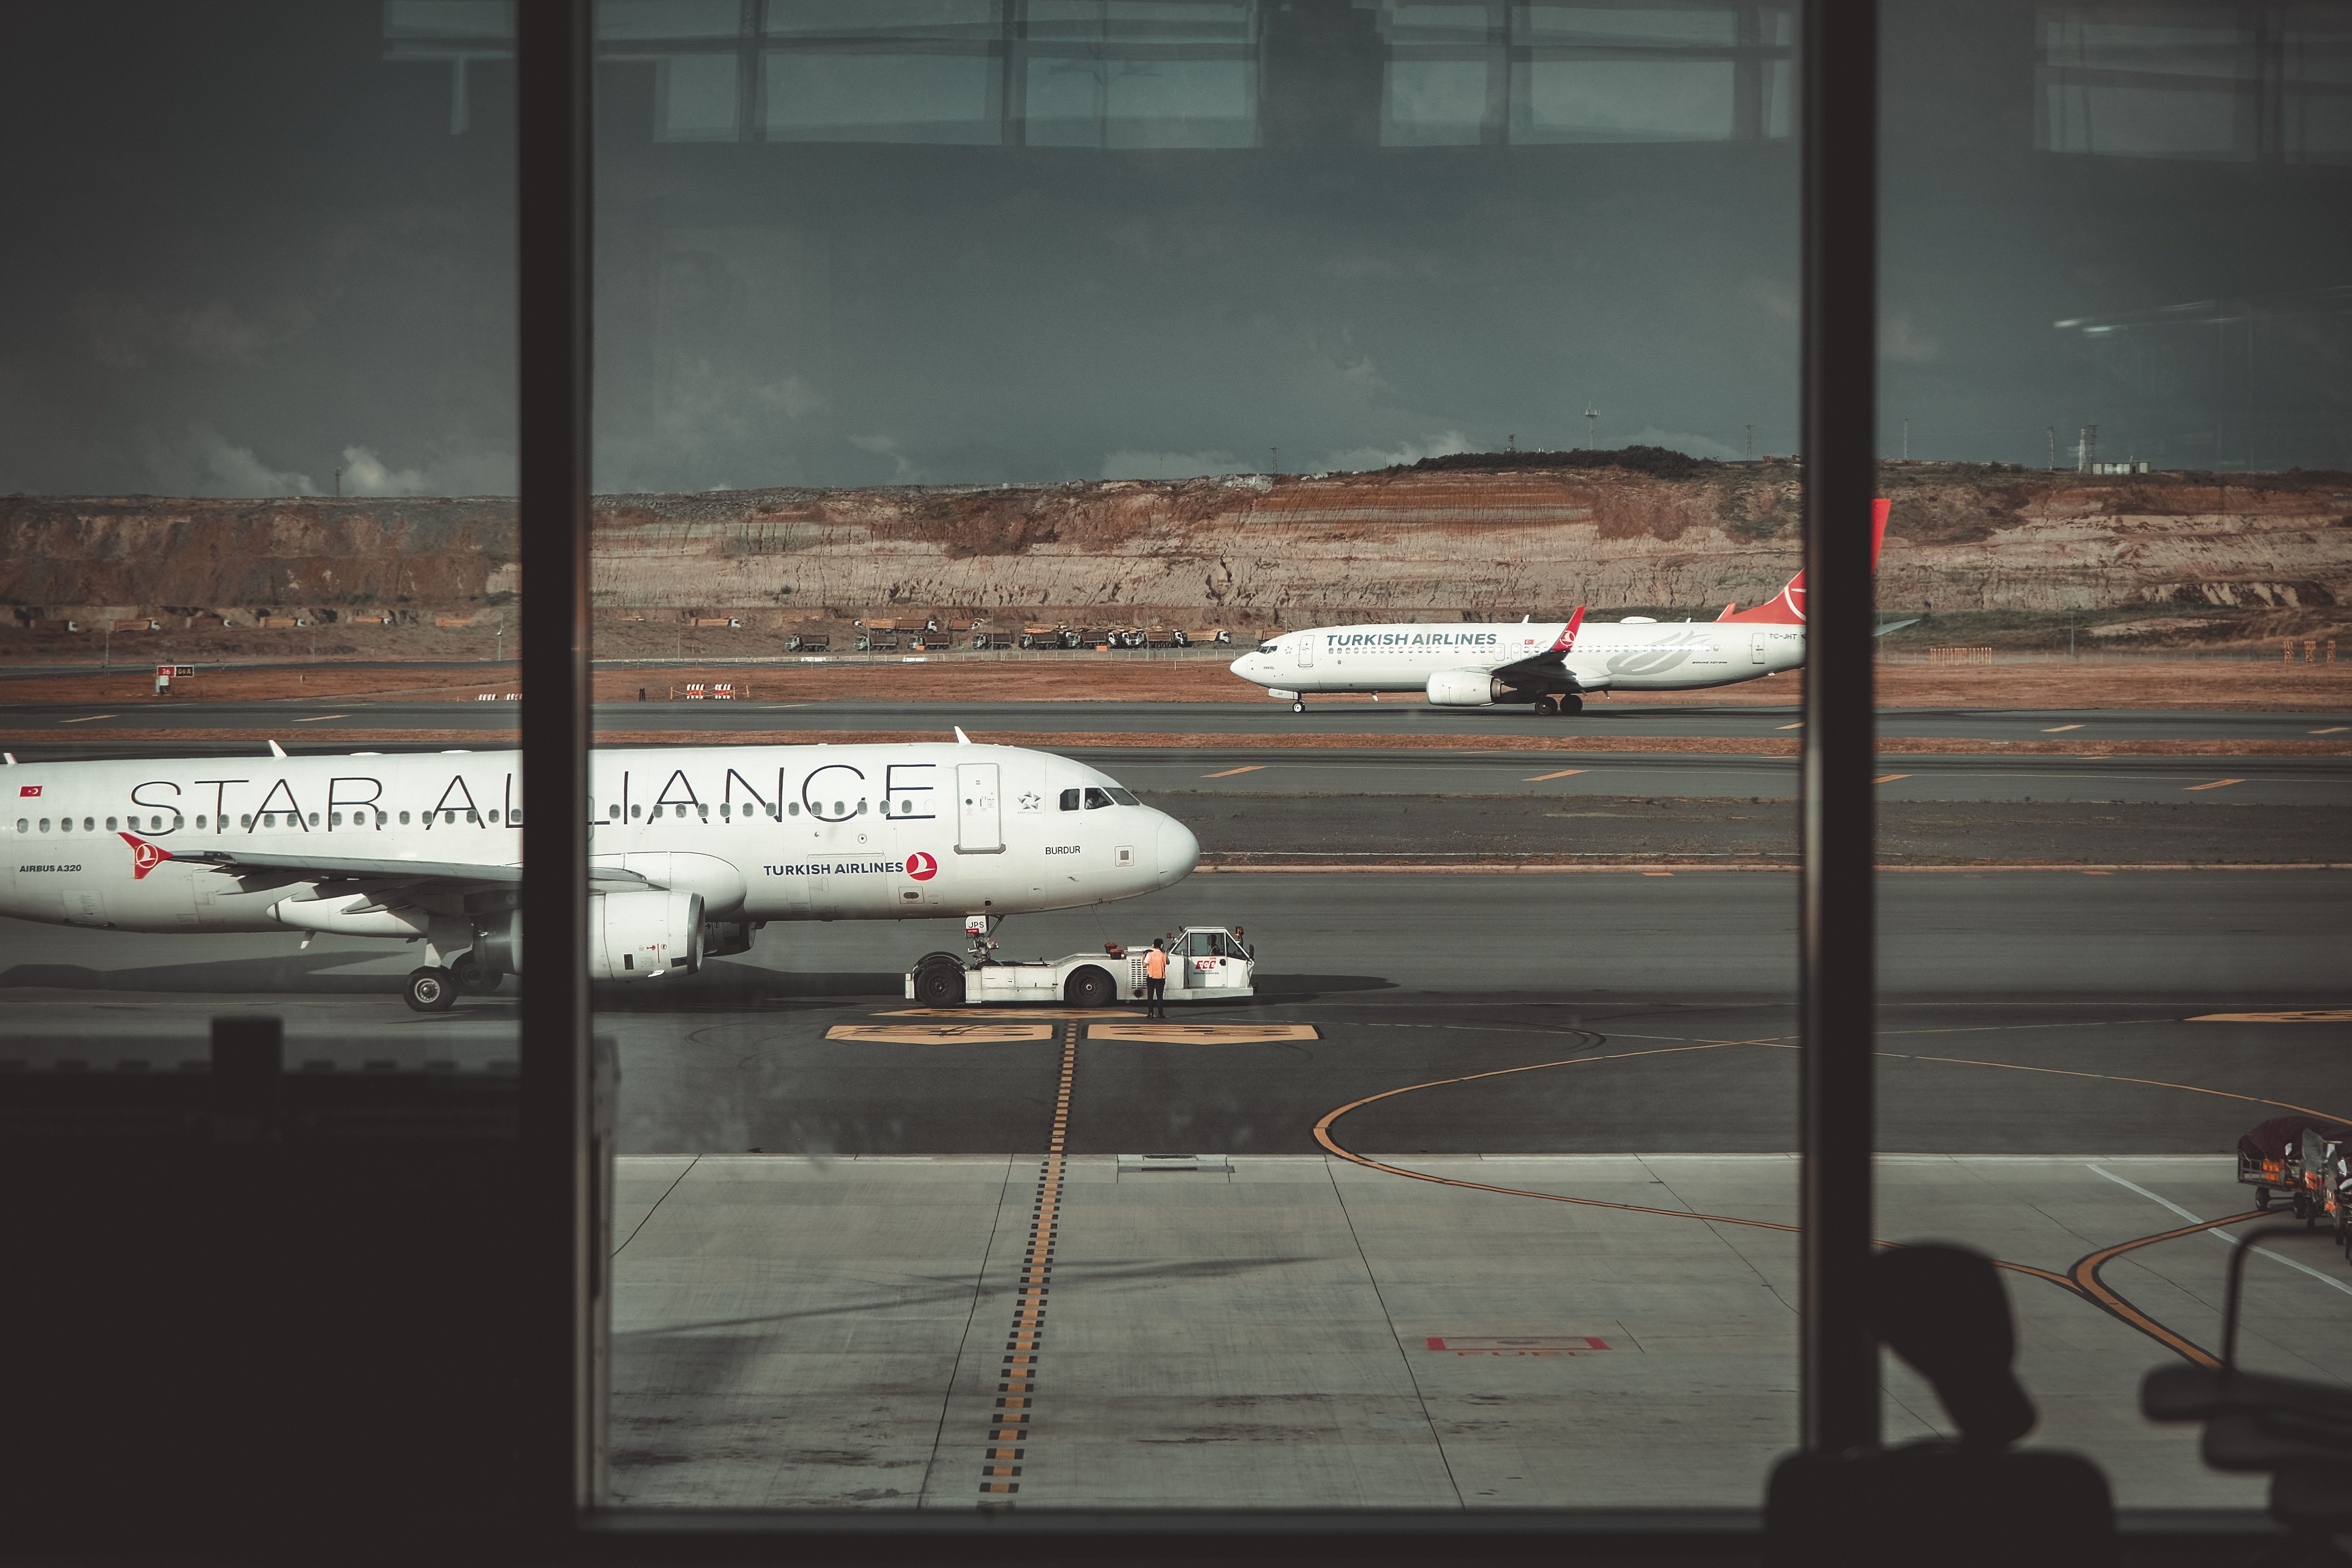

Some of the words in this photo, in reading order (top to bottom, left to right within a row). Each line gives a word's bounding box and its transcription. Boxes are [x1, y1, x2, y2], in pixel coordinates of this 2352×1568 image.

[1327, 634, 1409, 646] TURKISH
[1412, 633, 1497, 645] AIRLINES
[127, 777, 383, 836] STAR
[426, 764, 936, 830] ALIANCE
[1045, 846, 1080, 855] BURDUR
[764, 864, 830, 876] TURKISH
[834, 862, 904, 874] AIRLINES
